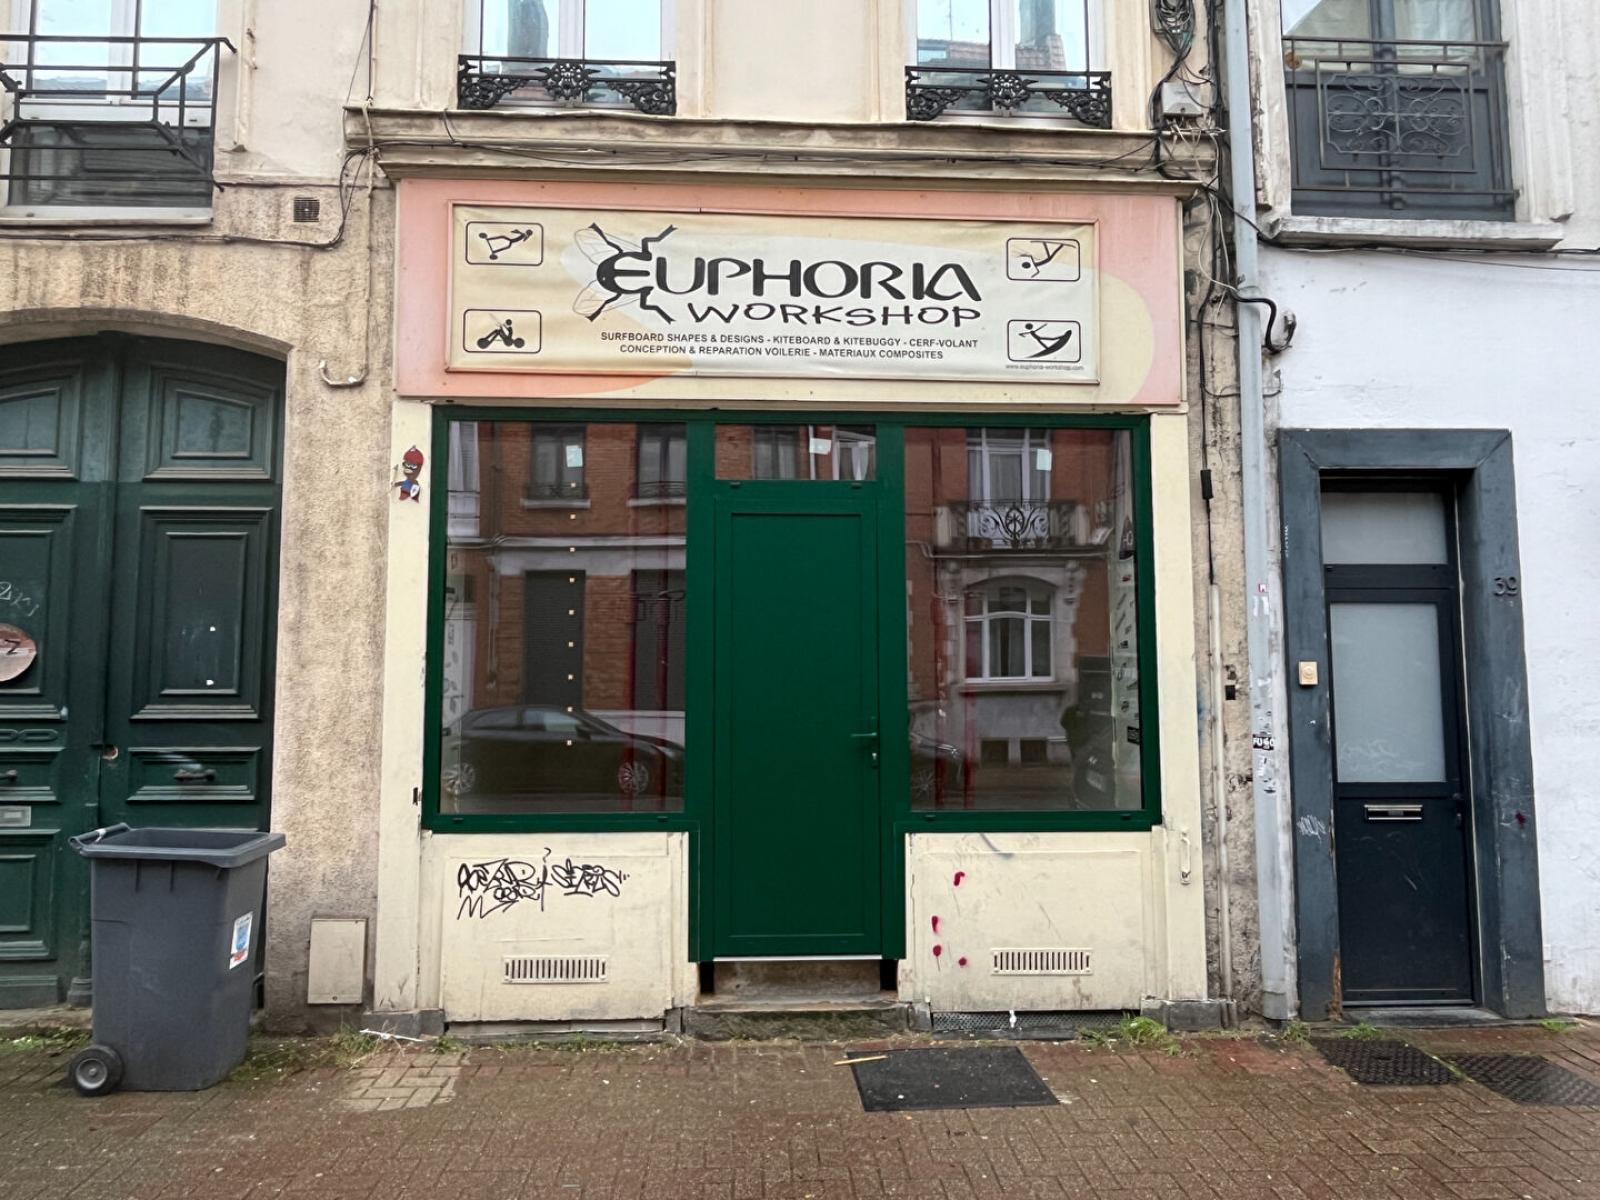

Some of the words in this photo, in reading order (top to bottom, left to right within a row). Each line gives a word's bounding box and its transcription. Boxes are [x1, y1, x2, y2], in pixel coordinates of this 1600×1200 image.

[596, 251, 982, 301] EUPHORIA
[687, 302, 981, 328] WORKSHOP
[600, 331, 664, 342] SURFBOARD
[667, 333, 708, 343] SHAPES
[710, 334, 717, 343] &
[720, 334, 764, 344] DESIGNS
[773, 335, 830, 345] KITEBOARD
[834, 336, 840, 345] &
[843, 337, 901, 347] KITEBUGGY
[909, 338, 978, 348] CERF-VOLANT
[620, 344, 686, 354] CONCEPTION
[689, 346, 695, 354] &
[699, 346, 762, 356] REPARATION
[765, 347, 811, 357] VOILERIE
[819, 348, 876, 358] MATERIAUX
[879, 350, 944, 360] COMPOSITES
[1493, 576, 1518, 597] 39
